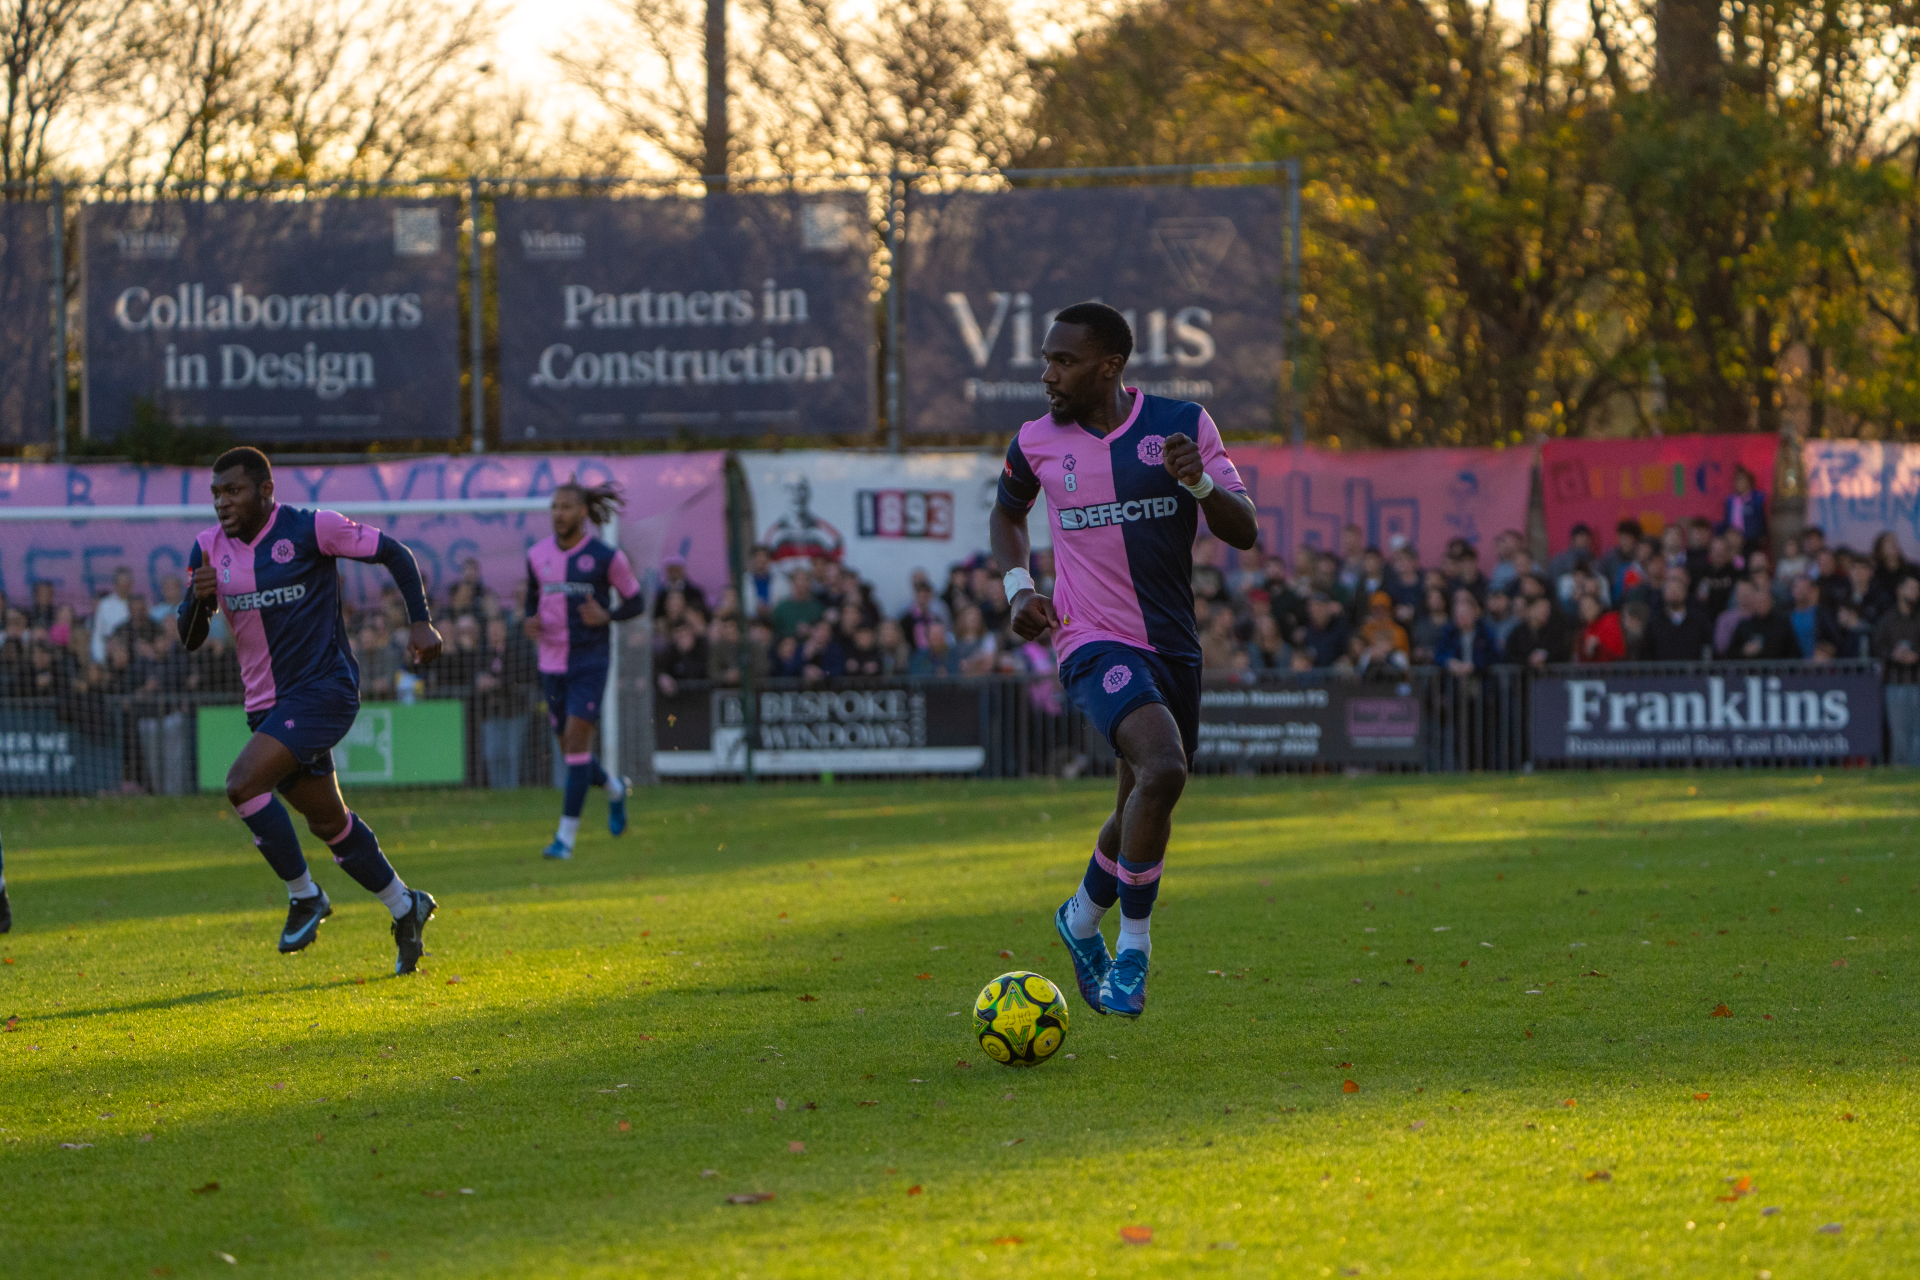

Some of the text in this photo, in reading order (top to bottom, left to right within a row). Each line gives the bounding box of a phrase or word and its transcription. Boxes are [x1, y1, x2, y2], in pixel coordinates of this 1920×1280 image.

[114, 283, 423, 330] Collaborators
[562, 278, 809, 329] Partners in
[945, 290, 1216, 368] Vius
[164, 342, 375, 398] in Design
[538, 338, 835, 389] Construction
[1064, 472, 1077, 492] 8
[1059, 496, 1178, 530] DEFECTED
[222, 568, 231, 584] 3
[224, 583, 306, 611] DEFECTED
[760, 690, 908, 722] BESPOKE
[1565, 676, 1849, 731] Franklins
[0, 732, 32, 751] ER
[760, 721, 910, 748] WINDOWS
